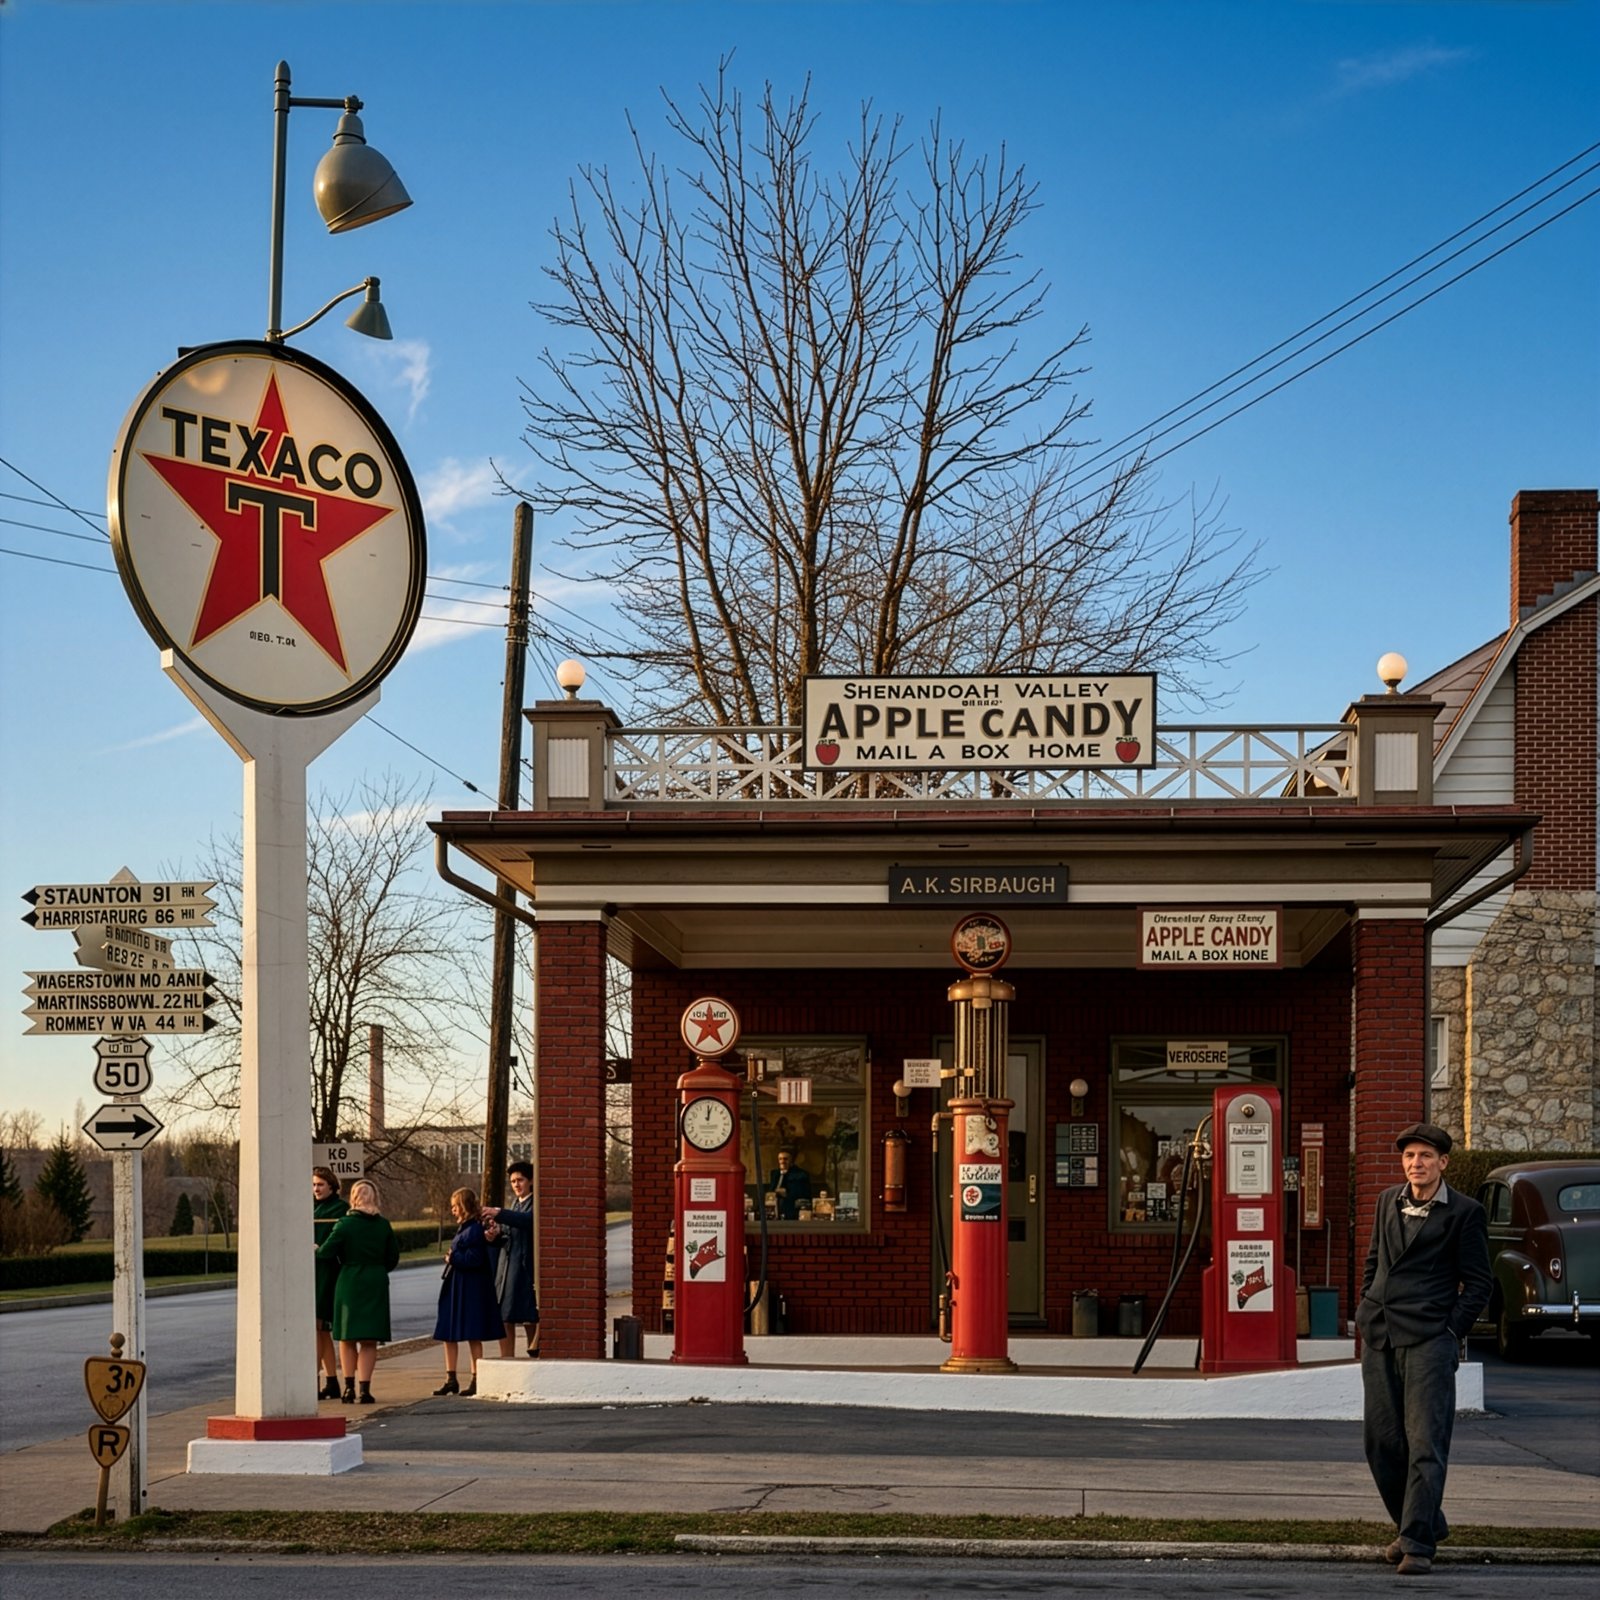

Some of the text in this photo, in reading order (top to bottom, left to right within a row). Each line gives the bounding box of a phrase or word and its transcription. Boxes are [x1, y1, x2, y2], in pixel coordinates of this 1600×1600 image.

[162, 406, 382, 499] TEXACO
[844, 683, 1109, 700] SHENANDOAH VALLEY
[820, 699, 1143, 739] APPLE CANDY
[857, 743, 1101, 760] MAIL A BOX HOME
[949, 877, 1055, 893] SIRBAUGH
[44, 887, 142, 905] STAUNTON
[152, 886, 171, 902] 91
[155, 908, 175, 924] 86
[1145, 926, 1273, 946] APPLE CANDY
[1151, 949, 1269, 961] MAIL A BOX HONE
[163, 993, 182, 1009] 22
[46, 1016, 105, 1031] ROMMEY
[111, 1016, 124, 1030] W
[128, 1016, 146, 1030] VA
[155, 1015, 175, 1030] 44
[105, 1062, 139, 1087] 50
[97, 1430, 120, 1457] R
